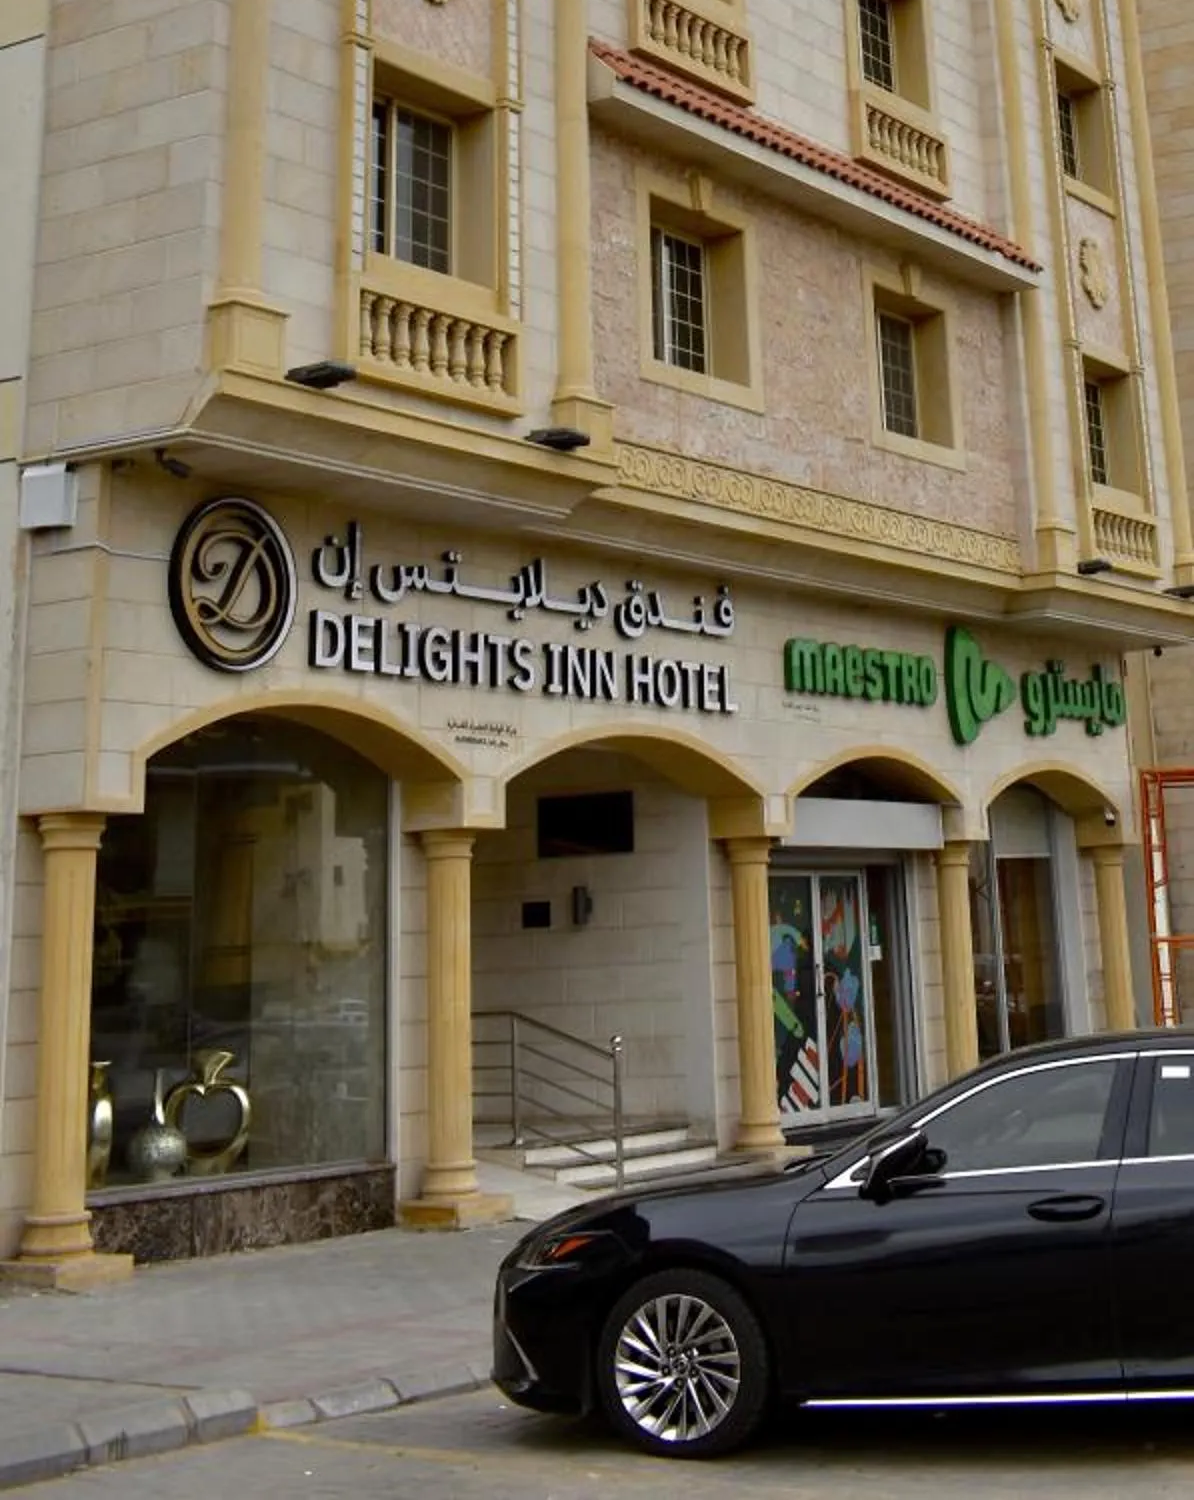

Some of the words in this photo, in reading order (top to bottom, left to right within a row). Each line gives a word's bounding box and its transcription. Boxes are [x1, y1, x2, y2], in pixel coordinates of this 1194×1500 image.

[311, 520, 363, 600] إن
[612, 578, 736, 639] فندق
[309, 608, 536, 693] DELIGHTS
[544, 641, 620, 700] INN
[626, 651, 740, 713] HOTEL
[1020, 660, 1127, 737] مايسترو
